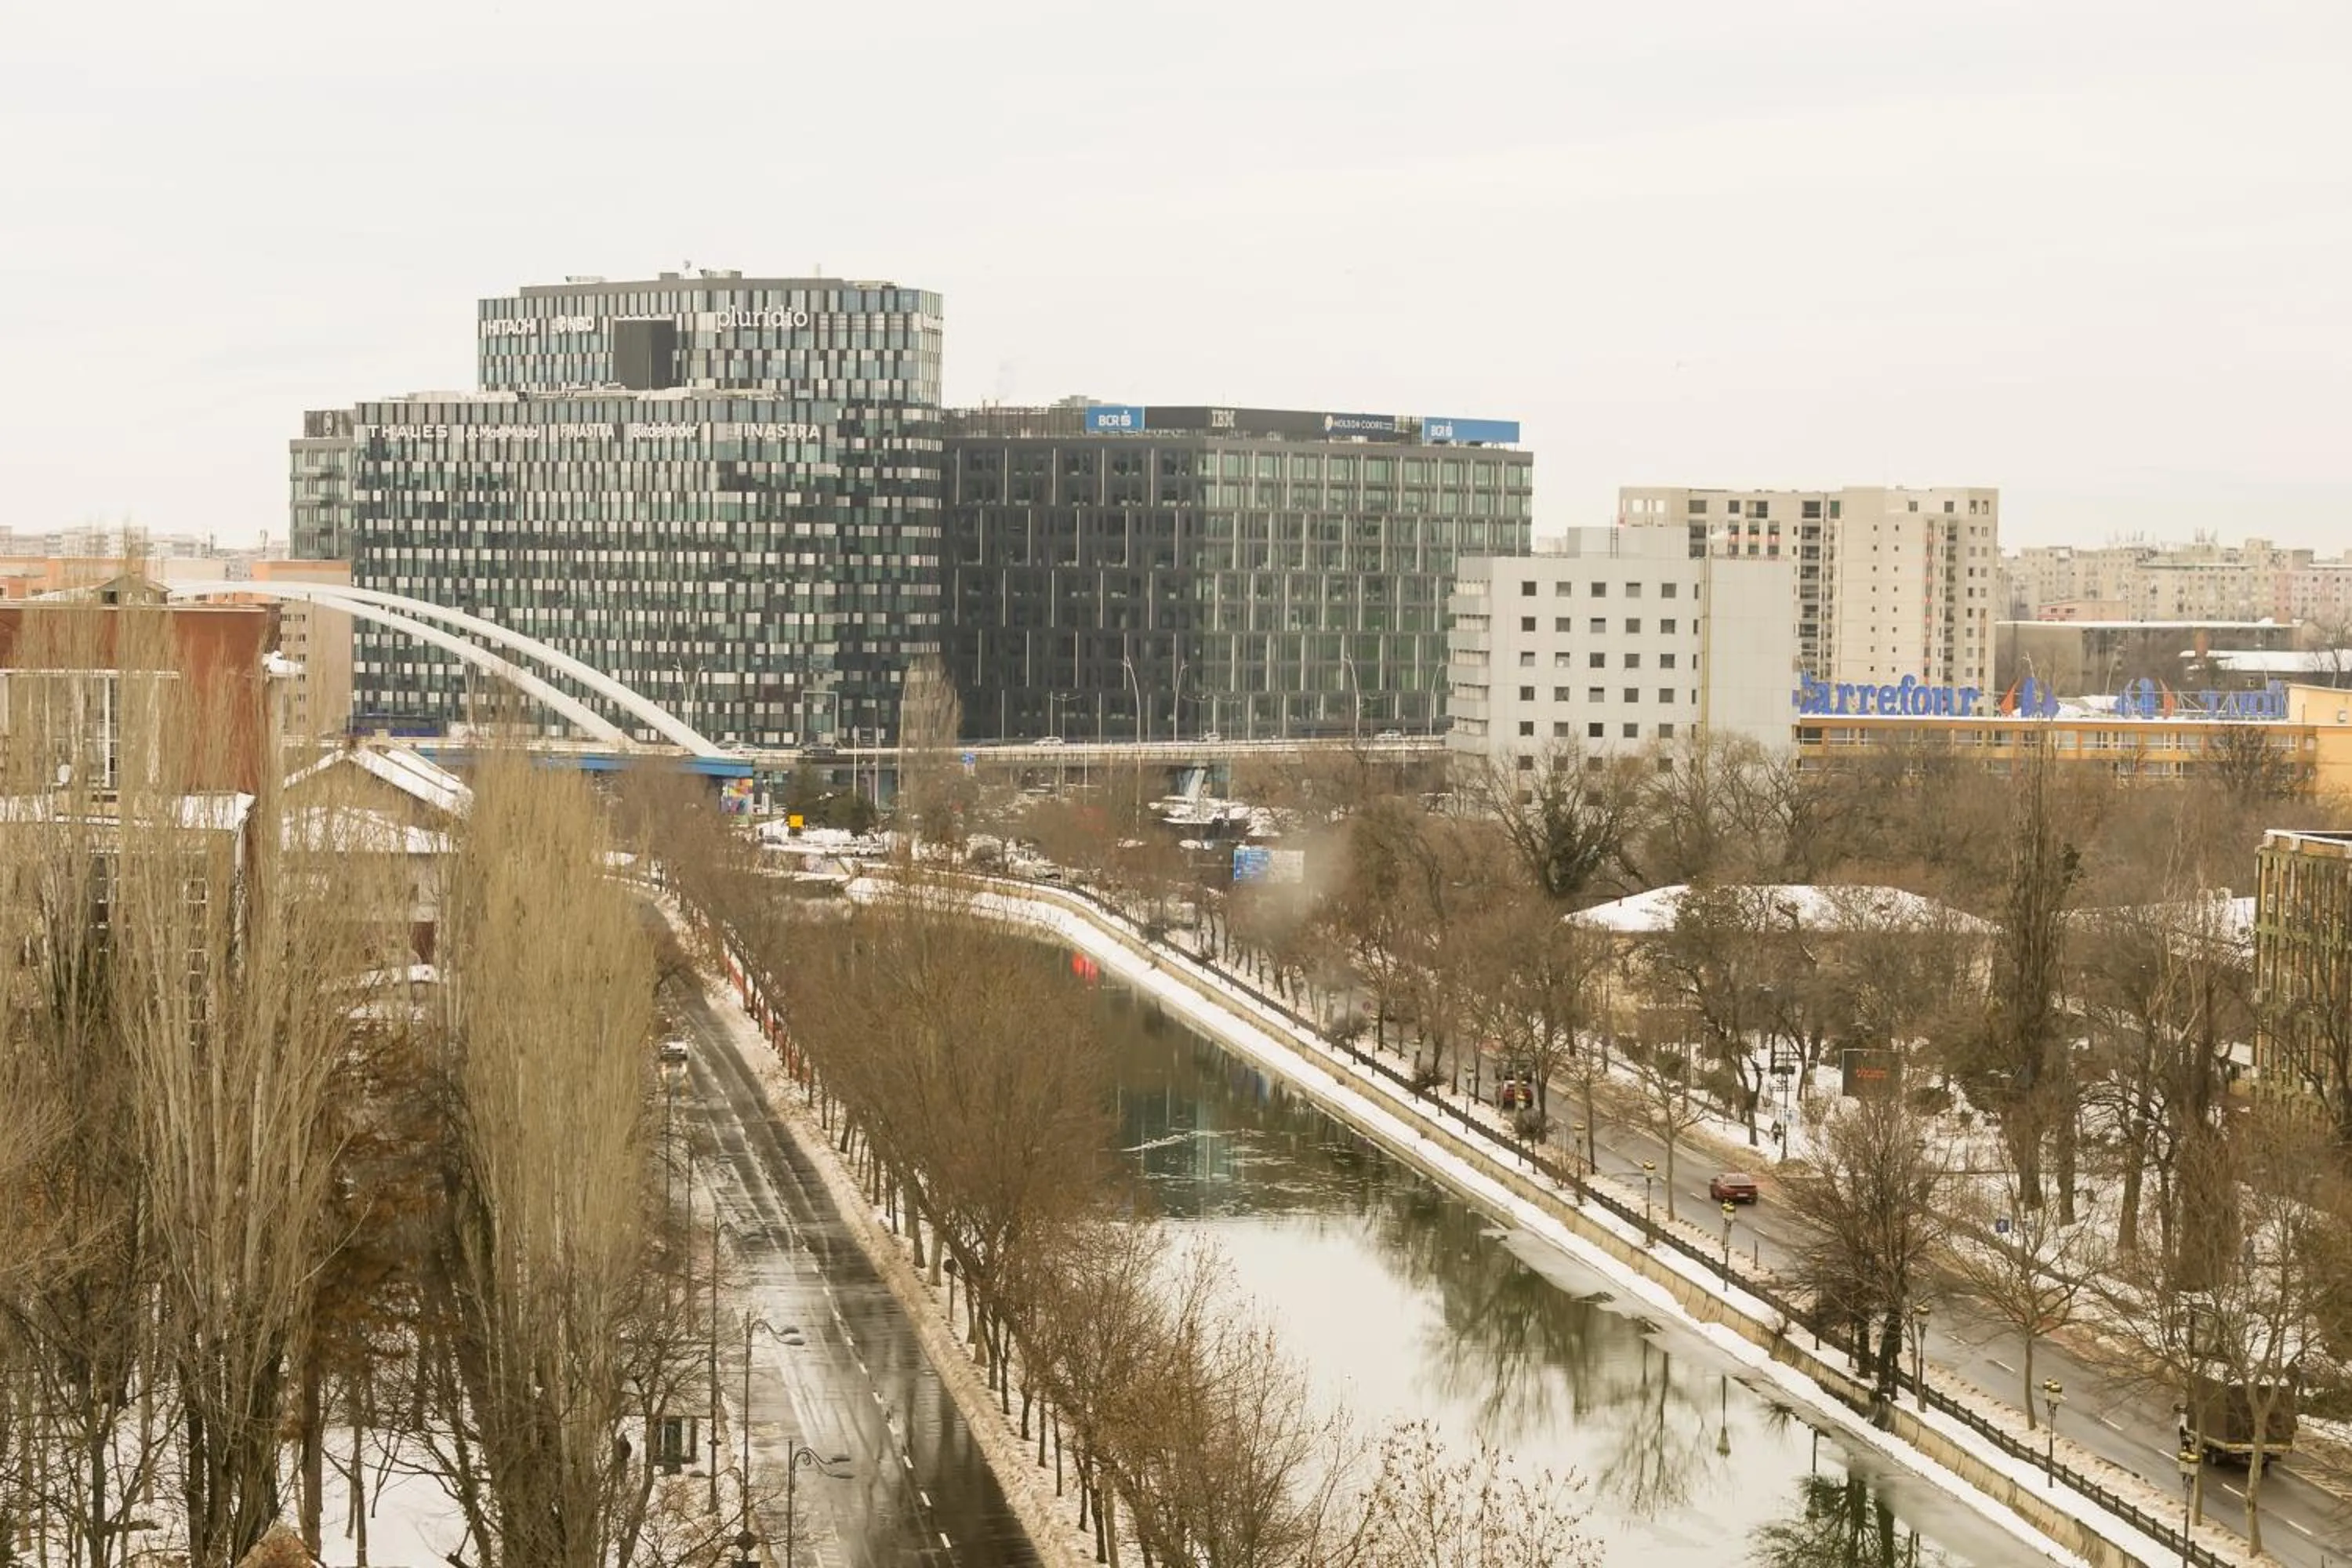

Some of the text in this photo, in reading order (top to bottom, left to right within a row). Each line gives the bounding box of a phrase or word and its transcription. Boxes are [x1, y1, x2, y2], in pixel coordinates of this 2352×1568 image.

[488, 317, 536, 336] HITACHI
[715, 305, 808, 333] pluridio
[1098, 415, 1119, 426] BCR
[1211, 409, 1236, 428] IBM
[367, 424, 448, 439] THALES
[560, 423, 615, 438] FINASTRA
[733, 423, 821, 439] FINASTRA
[1431, 424, 1444, 437] BCR
